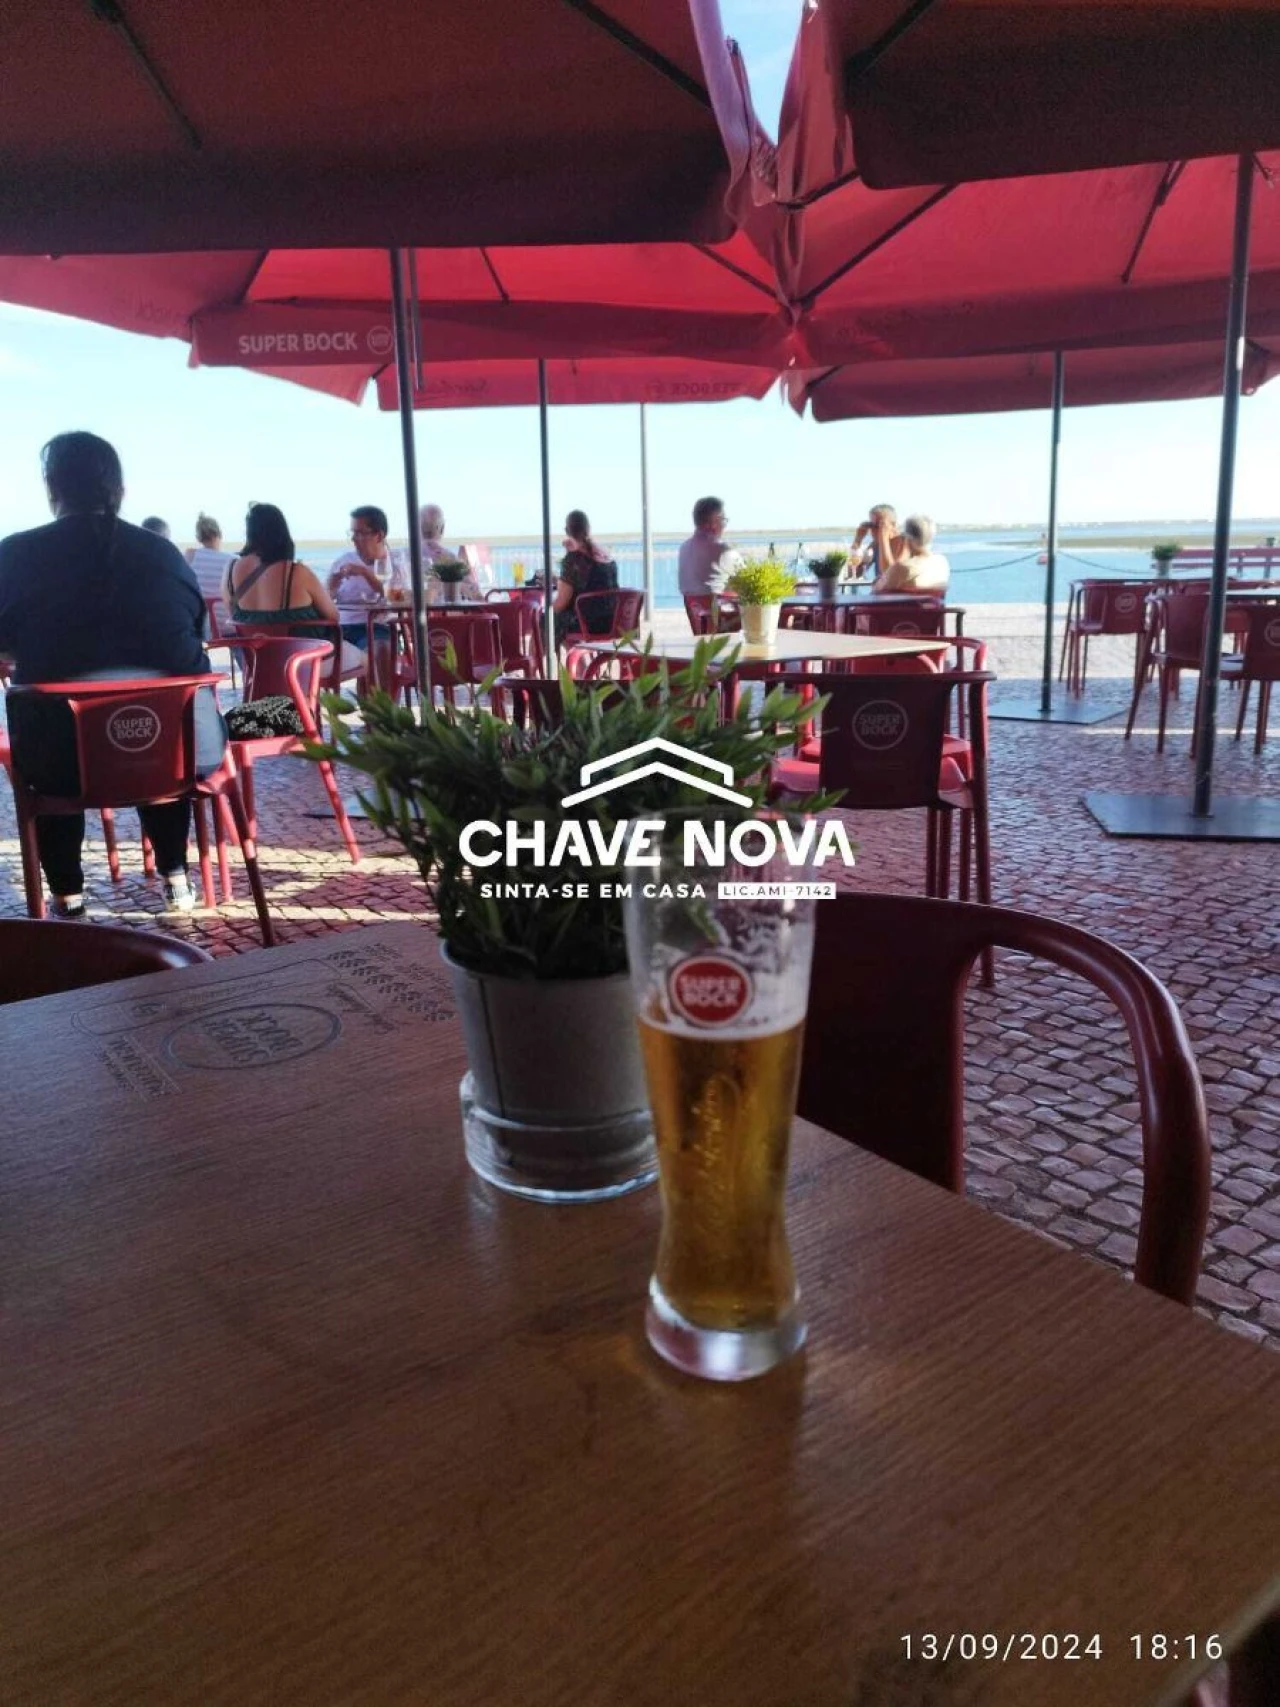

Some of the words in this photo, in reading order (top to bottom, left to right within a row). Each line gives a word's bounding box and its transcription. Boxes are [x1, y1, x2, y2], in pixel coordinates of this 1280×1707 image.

[239, 333, 299, 354] SUPER
[303, 332, 358, 351] BOCK
[113, 717, 153, 729] SUPER
[116, 727, 152, 739] BOCK
[680, 975, 740, 993] SUPER
[683, 992, 739, 1008] BOCK
